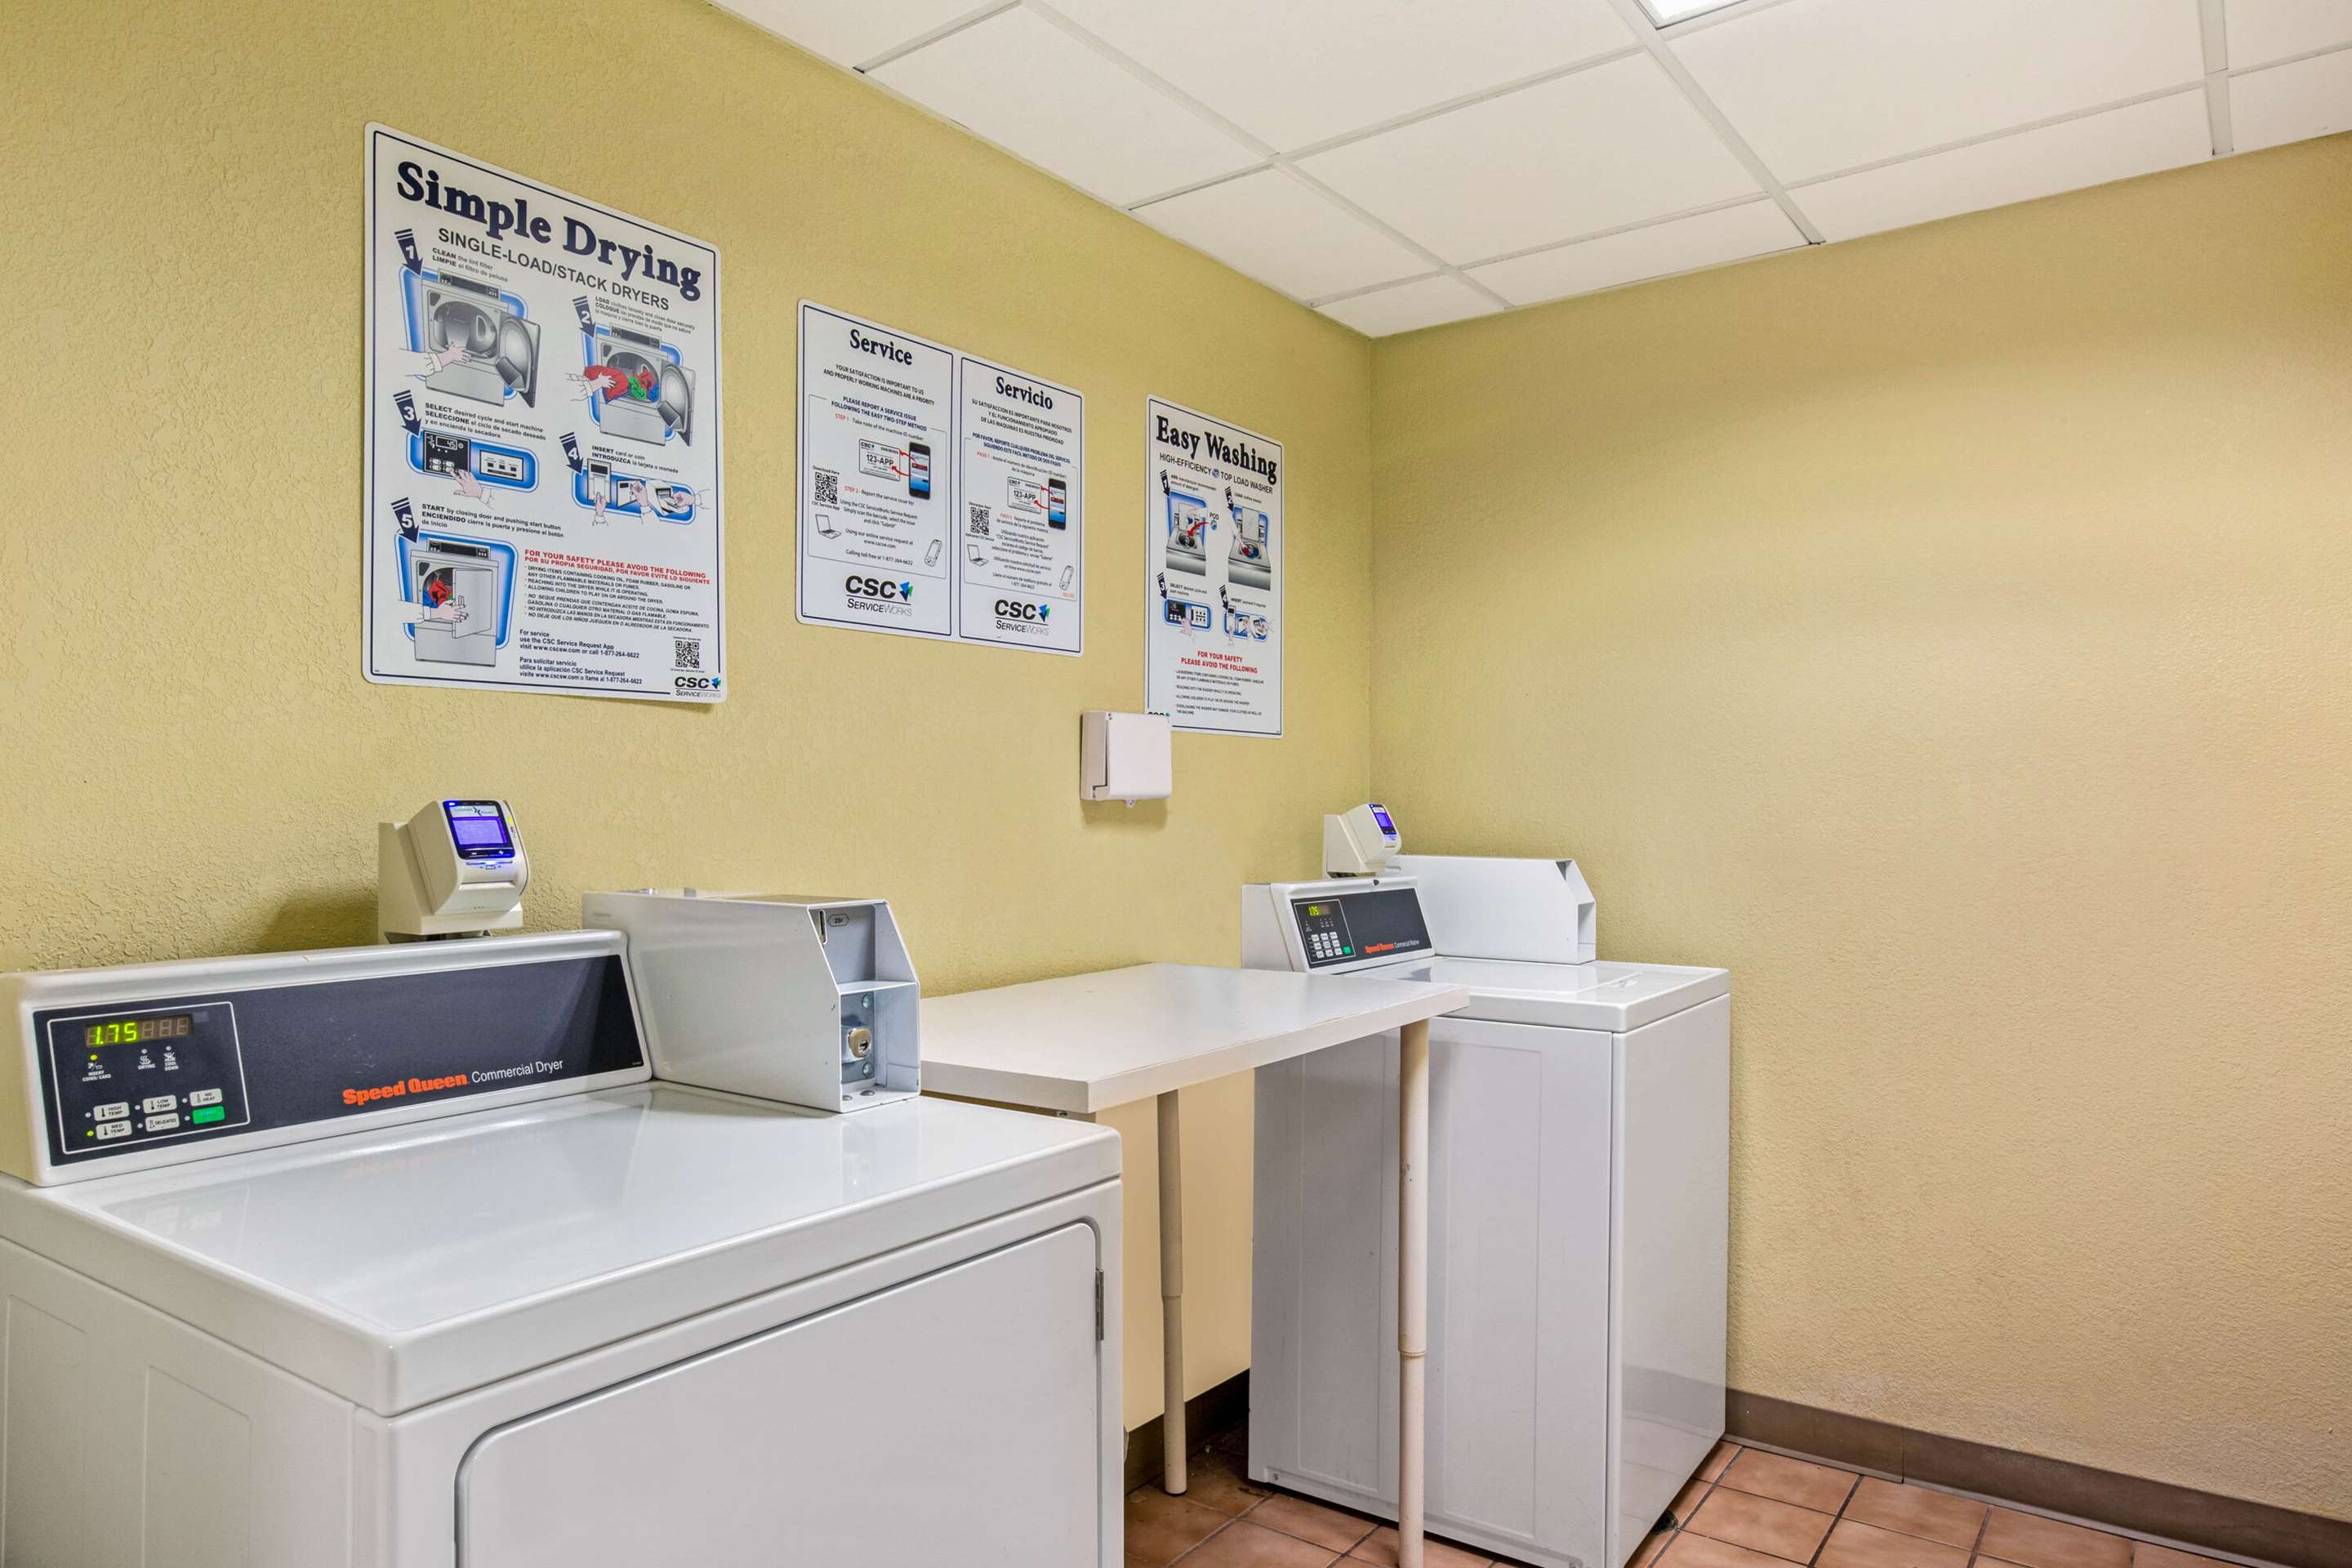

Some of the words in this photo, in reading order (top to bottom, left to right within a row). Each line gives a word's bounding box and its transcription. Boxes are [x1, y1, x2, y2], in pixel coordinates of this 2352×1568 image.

[397, 161, 551, 243] Simple
[563, 216, 702, 301] Drying
[439, 228, 607, 292] SINGLE-LOAD/STACK
[612, 282, 669, 310] DRYERS
[581, 310, 590, 324] 2
[850, 329, 912, 365] Service
[835, 372, 858, 384] PROPERLY
[858, 379, 880, 390] WORKING
[880, 385, 902, 397] MACHINES
[915, 396, 934, 406] PRIORITY
[836, 364, 849, 372] YOUR
[849, 368, 881, 382] SATISFACTION
[886, 379, 911, 391] IMPORTANT
[996, 376, 1053, 409] Servicio
[403, 407, 415, 421] 3
[425, 403, 452, 413] SELECT
[454, 408, 476, 419] desired
[478, 414, 492, 424] cycle
[506, 420, 519, 428] start
[520, 423, 543, 434] machine
[831, 401, 861, 413] FOLLOWING
[871, 412, 883, 420] EASY
[907, 421, 927, 431] METHOD
[843, 396, 861, 406] PLEASE
[862, 402, 880, 411] REPORT
[884, 408, 903, 417] SERVICE
[903, 413, 916, 421] ISSUE
[568, 448, 578, 460] 4
[592, 445, 614, 454] INSERT
[866, 454, 893, 466] 123-APP
[1156, 415, 1200, 460] Easy
[1205, 431, 1276, 485] Washing
[1160, 452, 1212, 474] HIGH-EFFICIENCY
[1221, 471, 1232, 480] TOP
[1234, 476, 1249, 487] LOAD
[1250, 480, 1273, 494] WASHER
[1013, 490, 1036, 501] 123-APP
[401, 514, 413, 528] 5
[422, 504, 444, 513] START
[456, 509, 478, 519] closing
[506, 517, 528, 528] pushing
[543, 523, 561, 532] button
[543, 552, 564, 560] YOUR
[566, 555, 595, 564] SAFETY
[597, 559, 625, 568] PLEASE
[666, 568, 706, 579] FOLLOWING
[577, 564, 615, 572] SEGURIDAD,
[679, 577, 710, 585] SIGUIENTE
[845, 575, 896, 599] CSC
[995, 599, 1036, 620] CSC
[579, 642, 602, 650] Request
[603, 644, 614, 652] App
[604, 670, 626, 678] Request
[1181, 657, 1201, 666] PLEASE
[1230, 665, 1258, 674] FOLLOWING
[675, 677, 709, 689] CSC
[95, 1022, 137, 1045] 1.75
[342, 1080, 405, 1106] Speed
[408, 1072, 468, 1094] Queen
[472, 1062, 533, 1084] Commercial
[536, 1059, 564, 1075] Dryer
